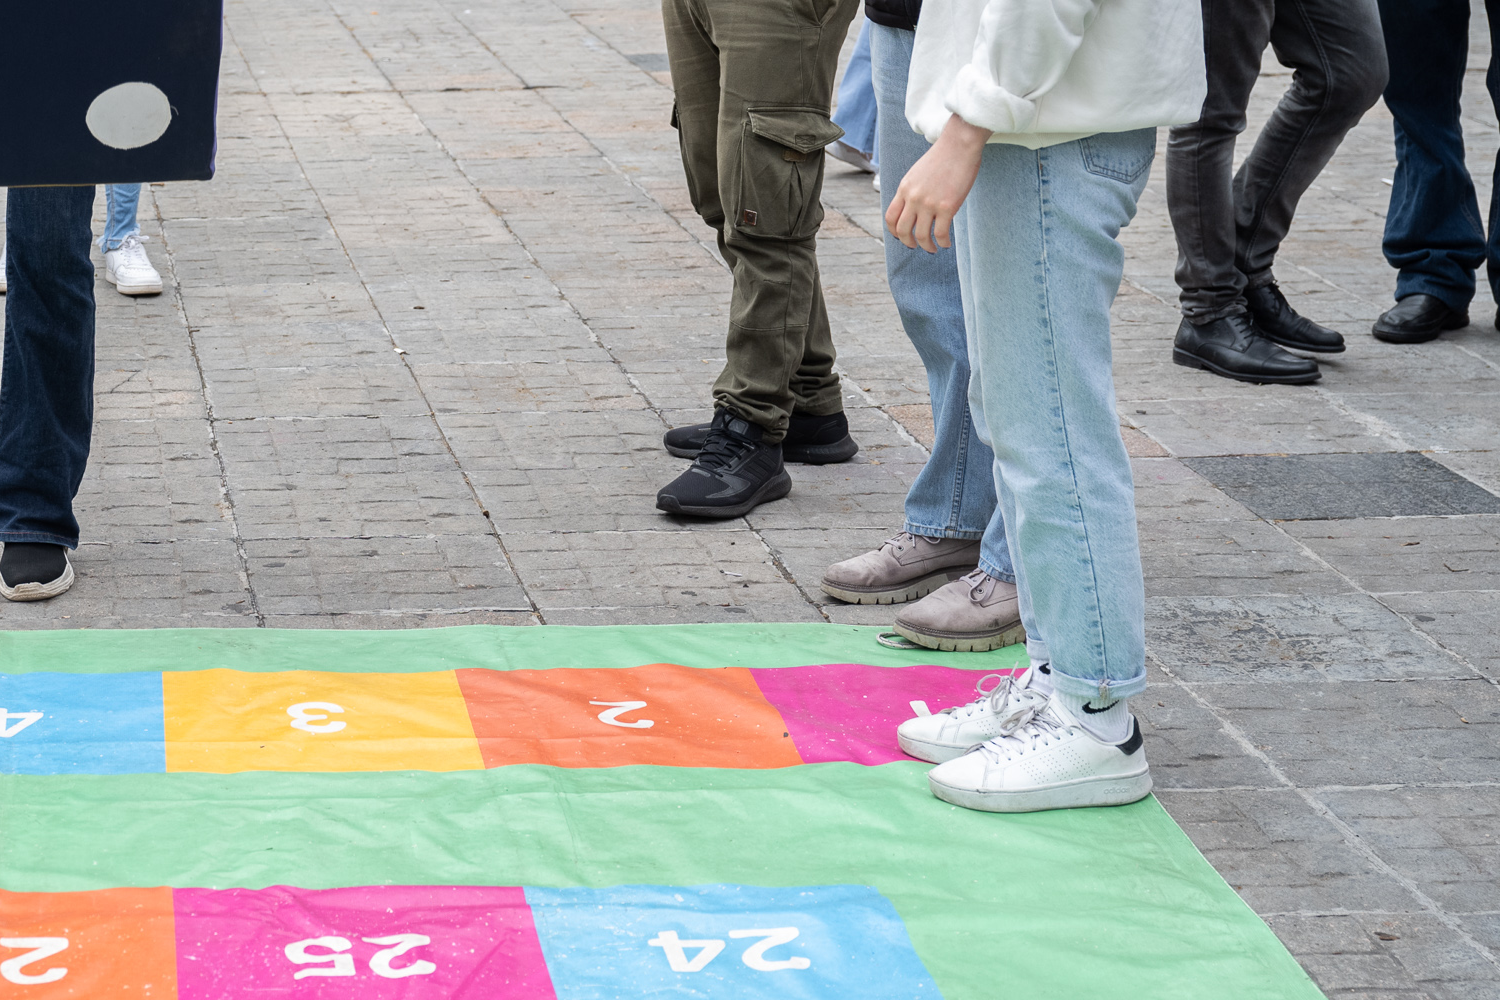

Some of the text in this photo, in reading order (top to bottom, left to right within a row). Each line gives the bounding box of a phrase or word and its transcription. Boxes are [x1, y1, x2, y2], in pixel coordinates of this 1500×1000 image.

[286, 701, 347, 736] 3
[588, 700, 655, 729] 2
[284, 933, 437, 980] 25
[647, 926, 811, 973] 24
